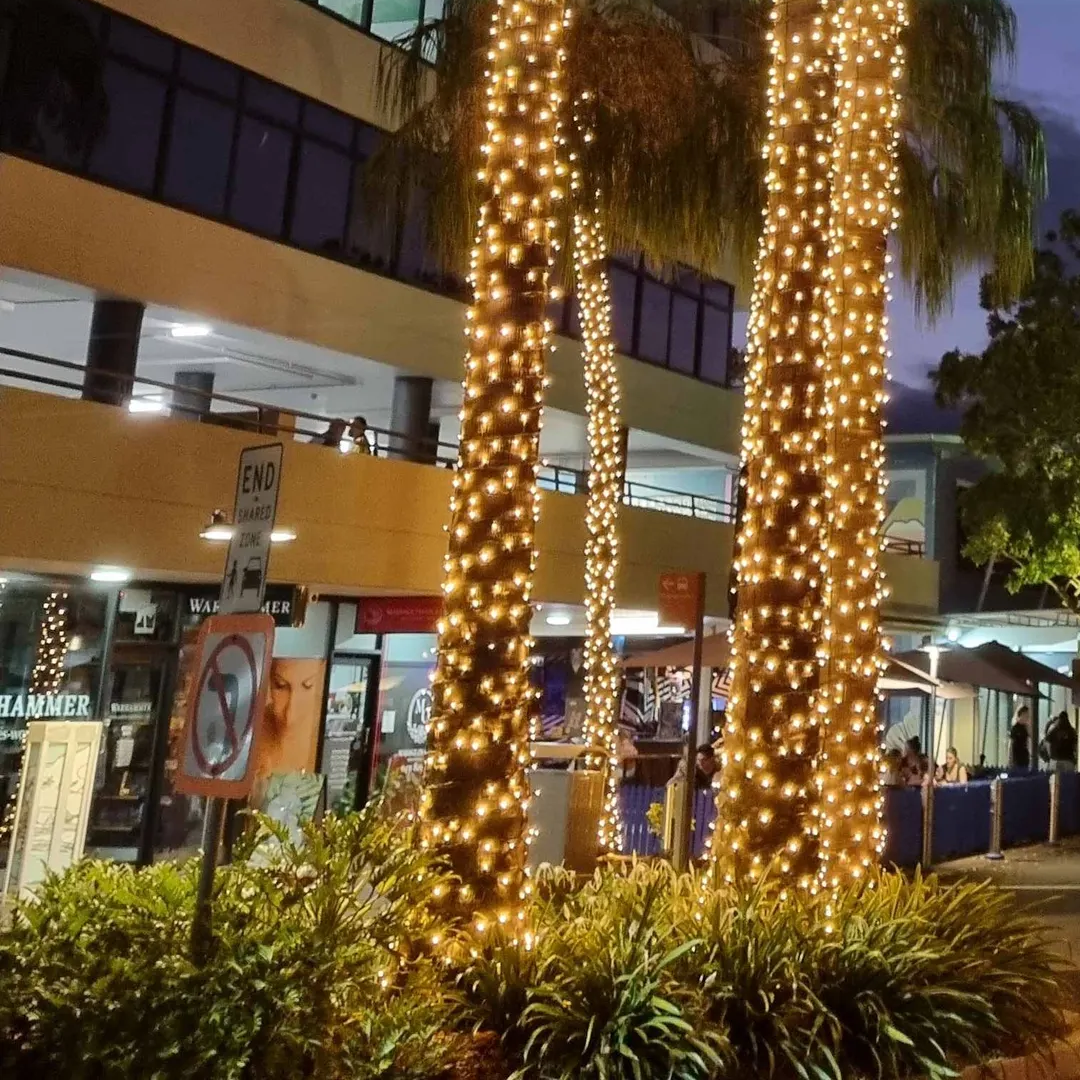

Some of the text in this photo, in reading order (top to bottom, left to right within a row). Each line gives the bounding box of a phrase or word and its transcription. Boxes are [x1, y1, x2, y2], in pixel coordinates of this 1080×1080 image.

[242, 461, 275, 494] END
[238, 504, 271, 523] SHARED
[239, 531, 262, 549] ZONE
